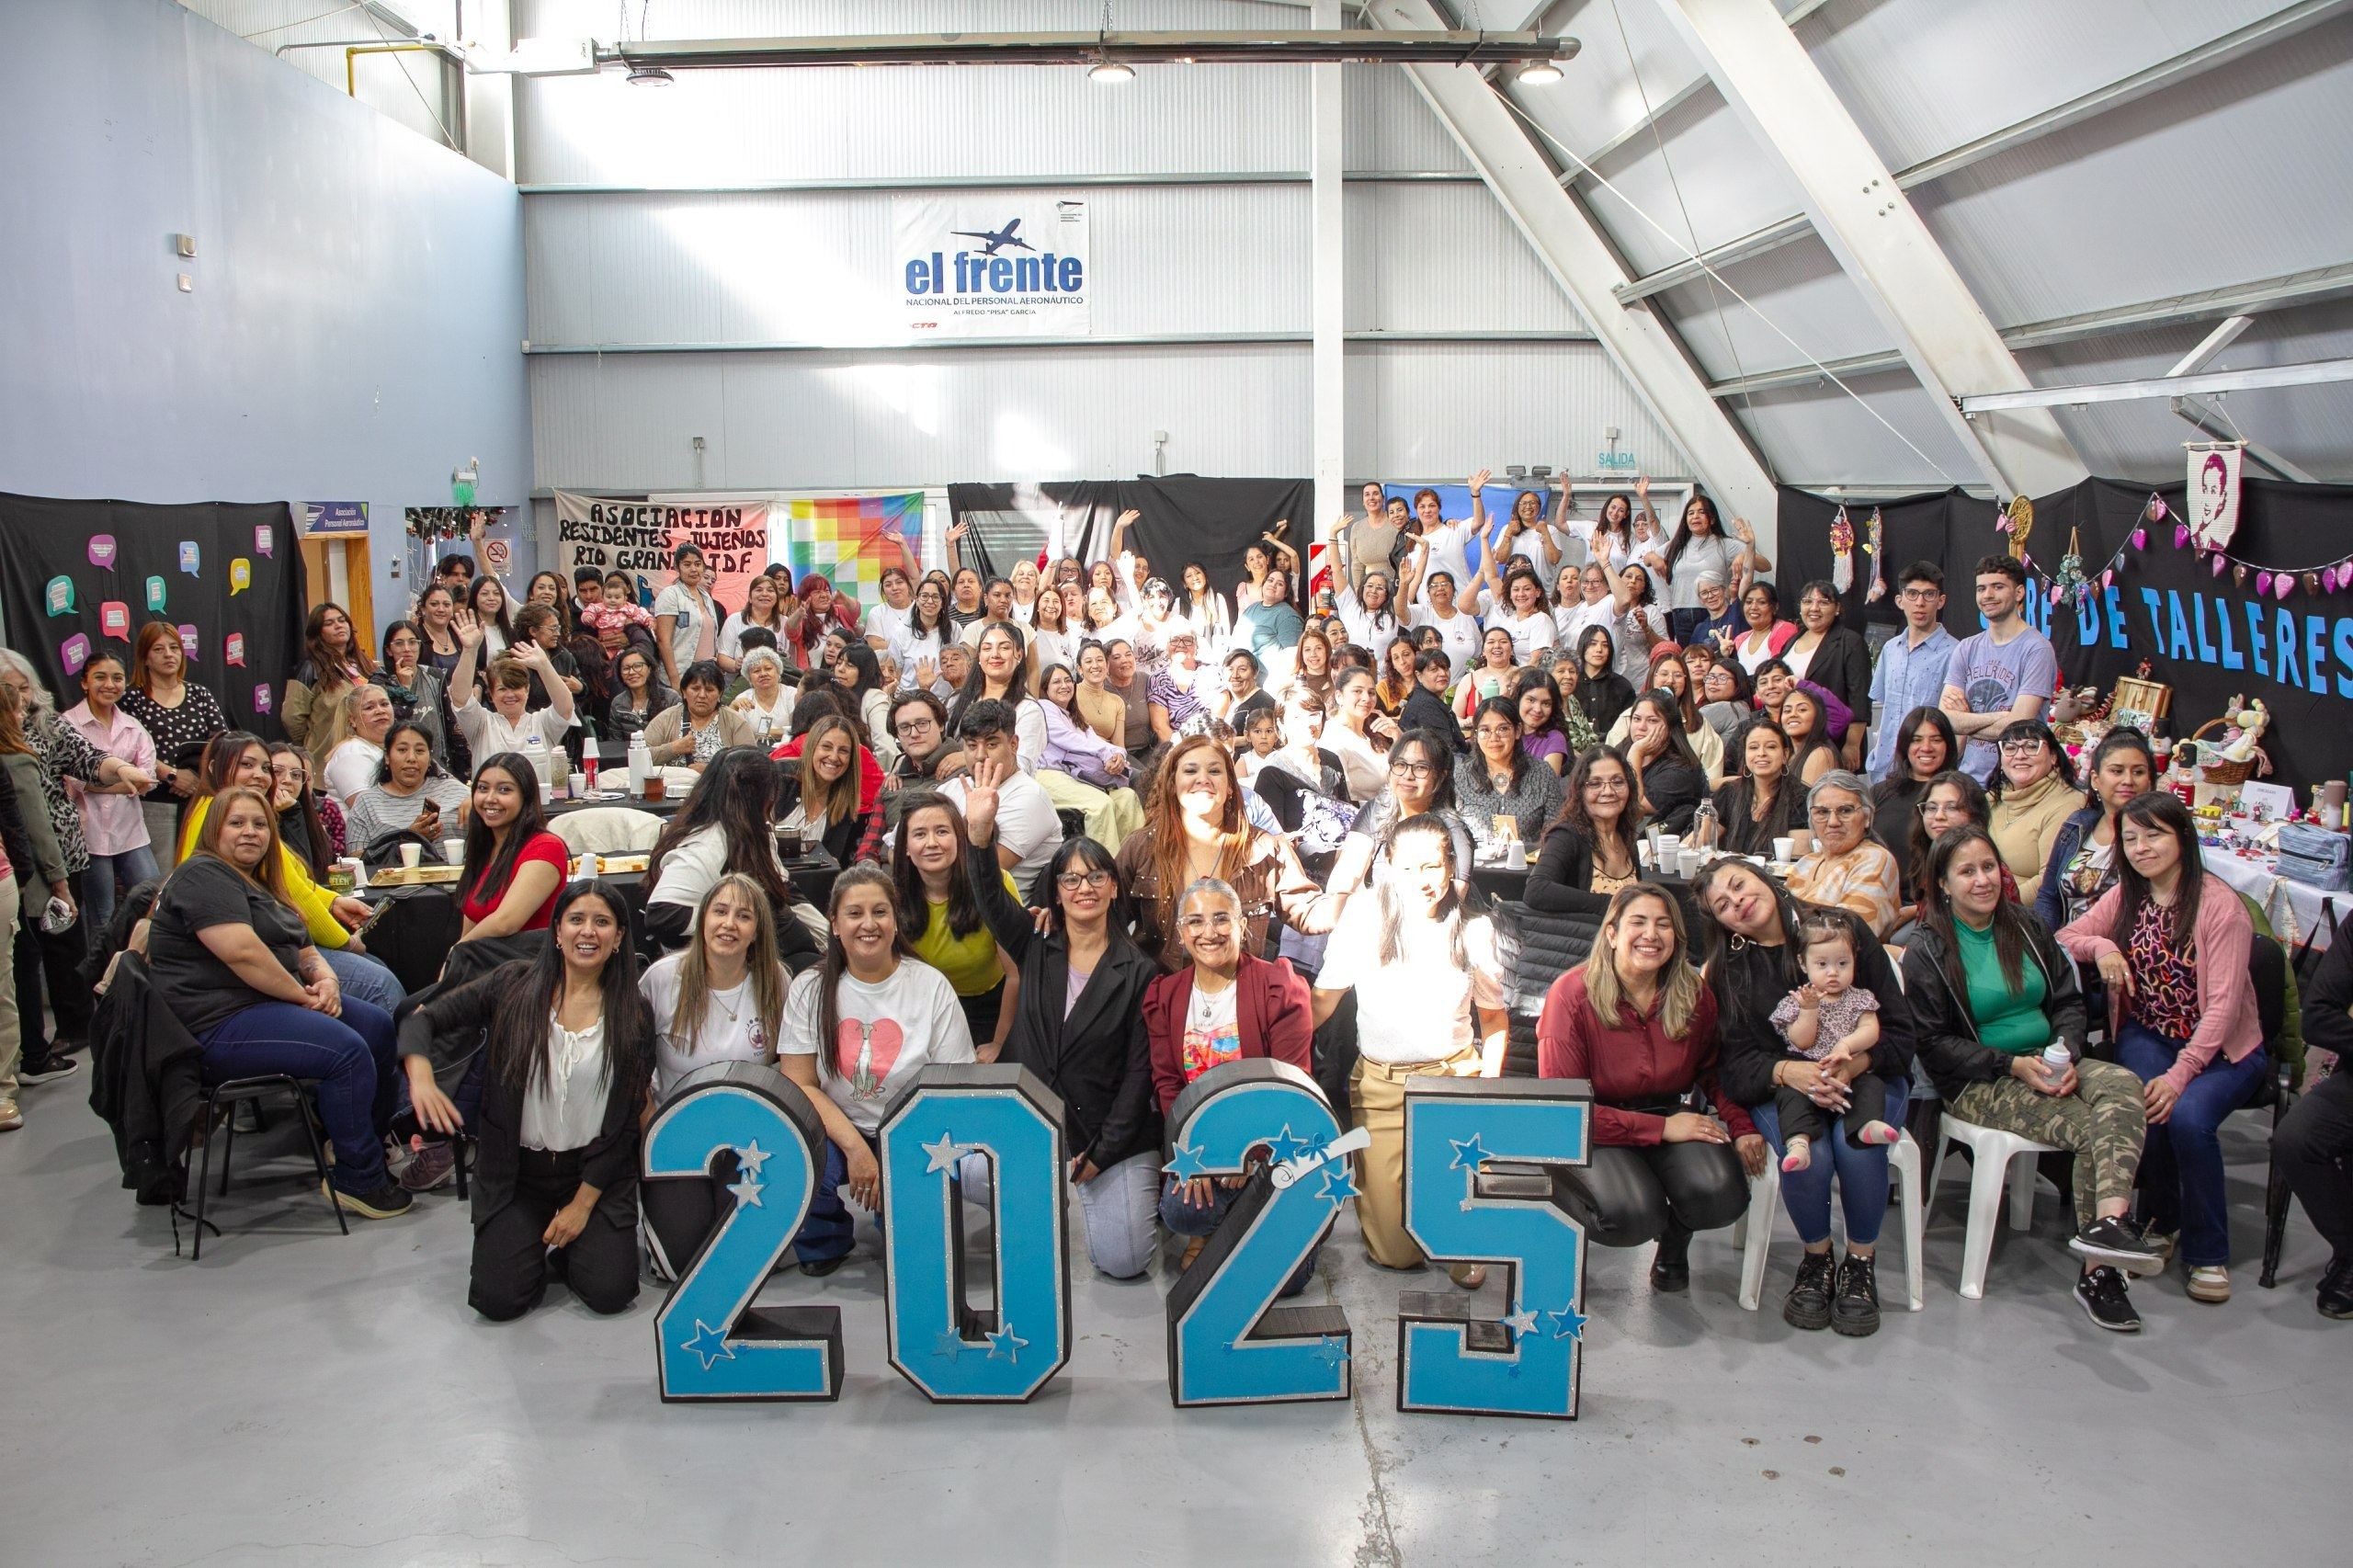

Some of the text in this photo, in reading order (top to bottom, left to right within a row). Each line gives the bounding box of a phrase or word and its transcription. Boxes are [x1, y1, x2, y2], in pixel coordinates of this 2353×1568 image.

[905, 251, 1083, 294] el frente
[906, 298, 951, 306] NACIONAL
[972, 297, 1018, 305] PERSONAL
[1019, 294, 1084, 305] AERONÁUTICO
[1598, 452, 1635, 465] SALIDA
[590, 503, 742, 528] ASOCIACIÓN
[559, 519, 766, 551] RESIDENTES JUJEÑOS
[573, 545, 607, 566] RIO
[616, 550, 676, 571] GRAN
[2141, 586, 2353, 699] TALLERES
[1965, 665, 2016, 689] HELLRIDER
[642, 1057, 1594, 1420] 2025
